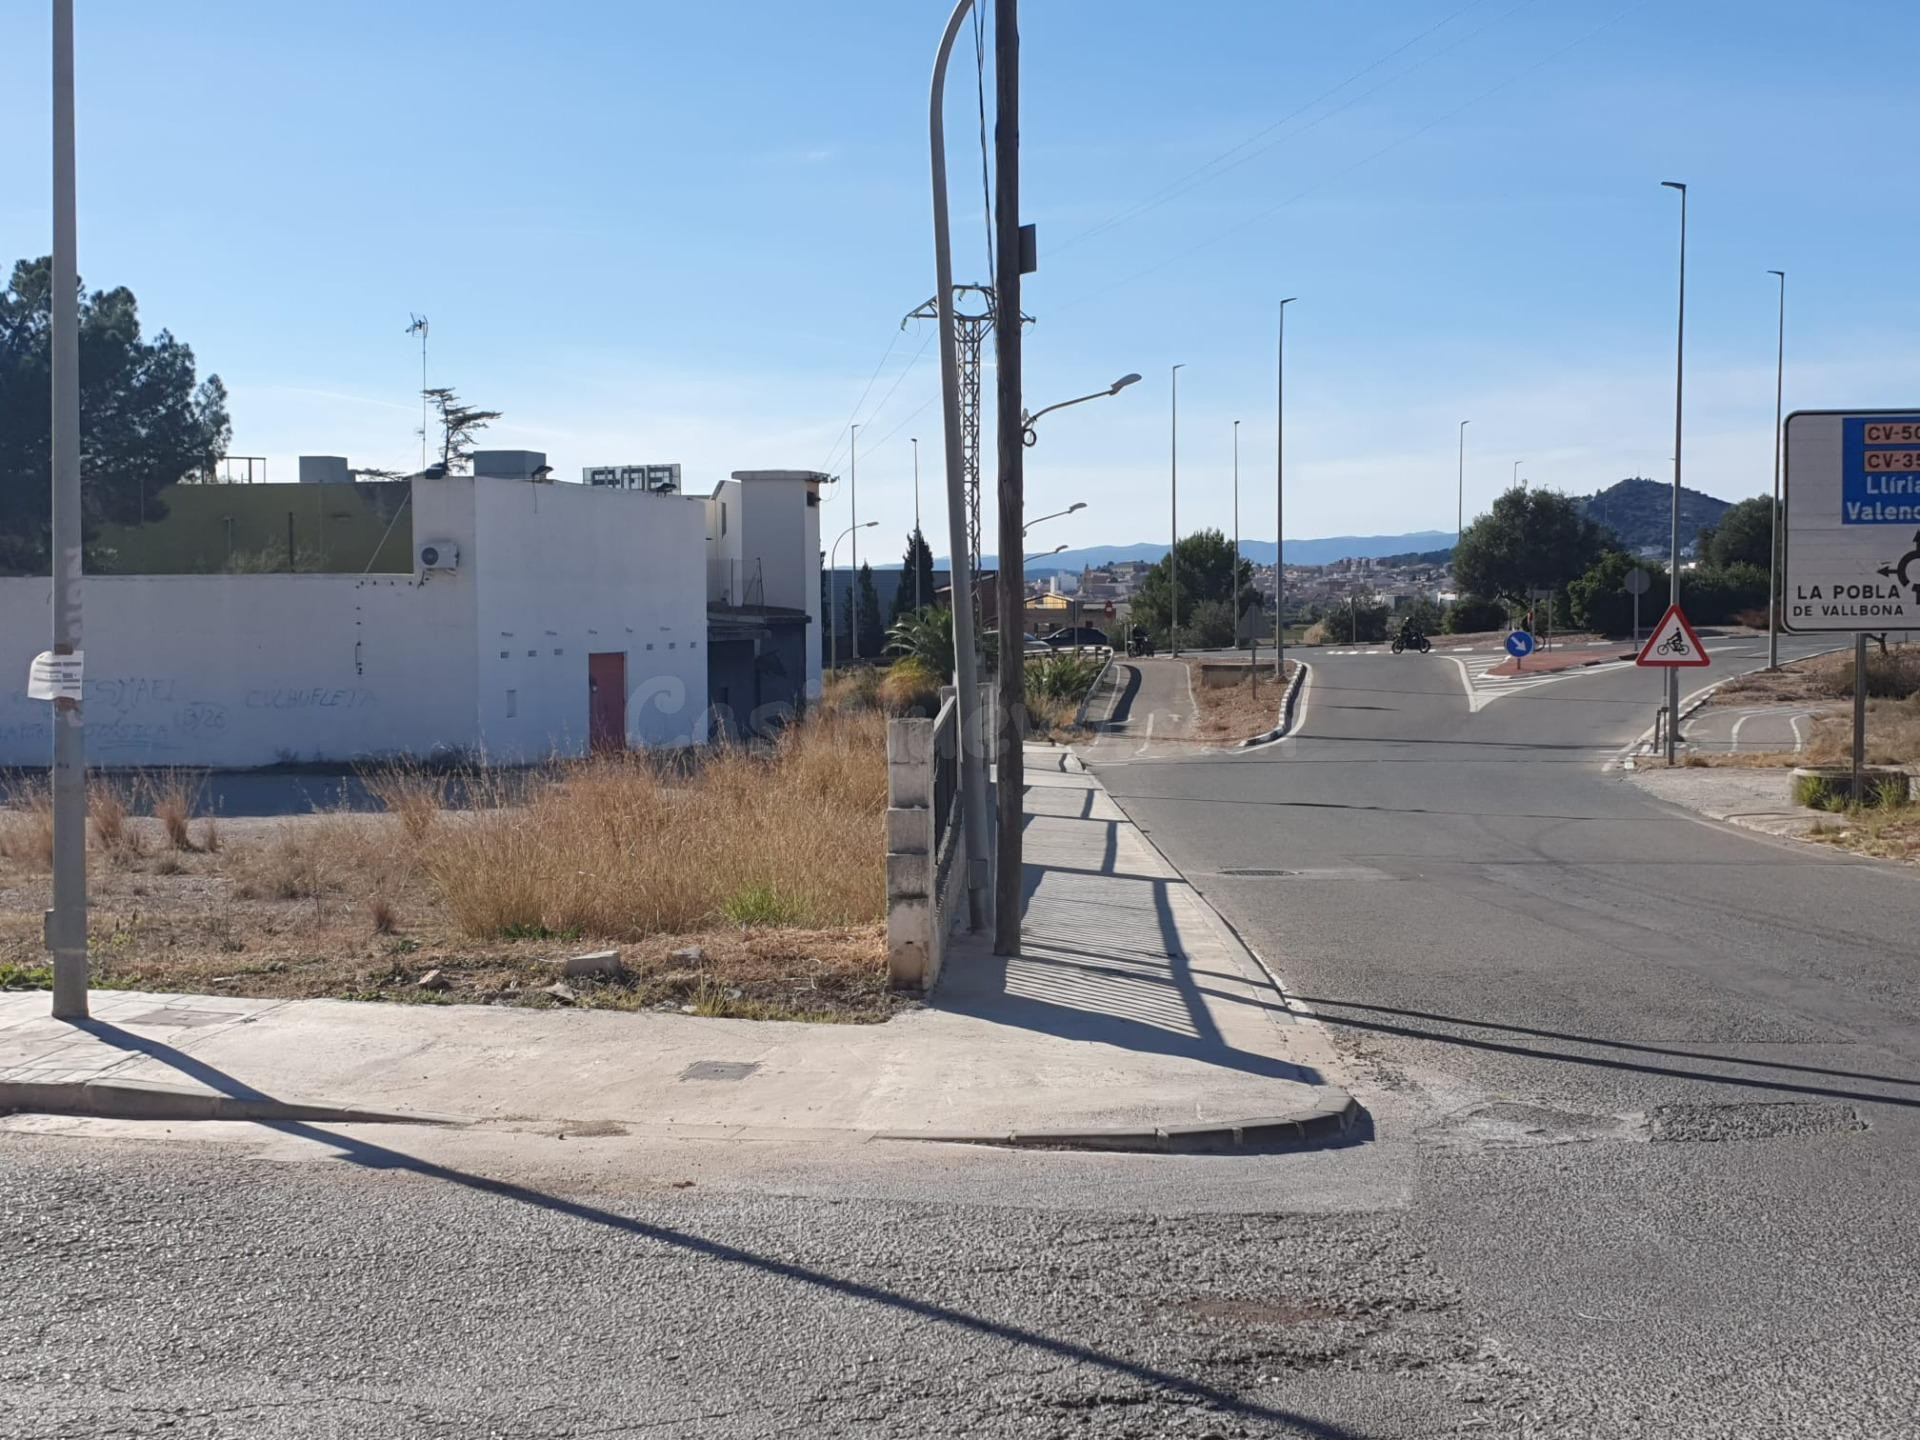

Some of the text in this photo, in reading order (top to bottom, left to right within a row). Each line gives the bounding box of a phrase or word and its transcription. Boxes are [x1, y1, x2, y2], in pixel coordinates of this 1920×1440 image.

[1797, 584, 1900, 600] LA POBLA
[1793, 604, 1904, 616] DE VALLBONA
